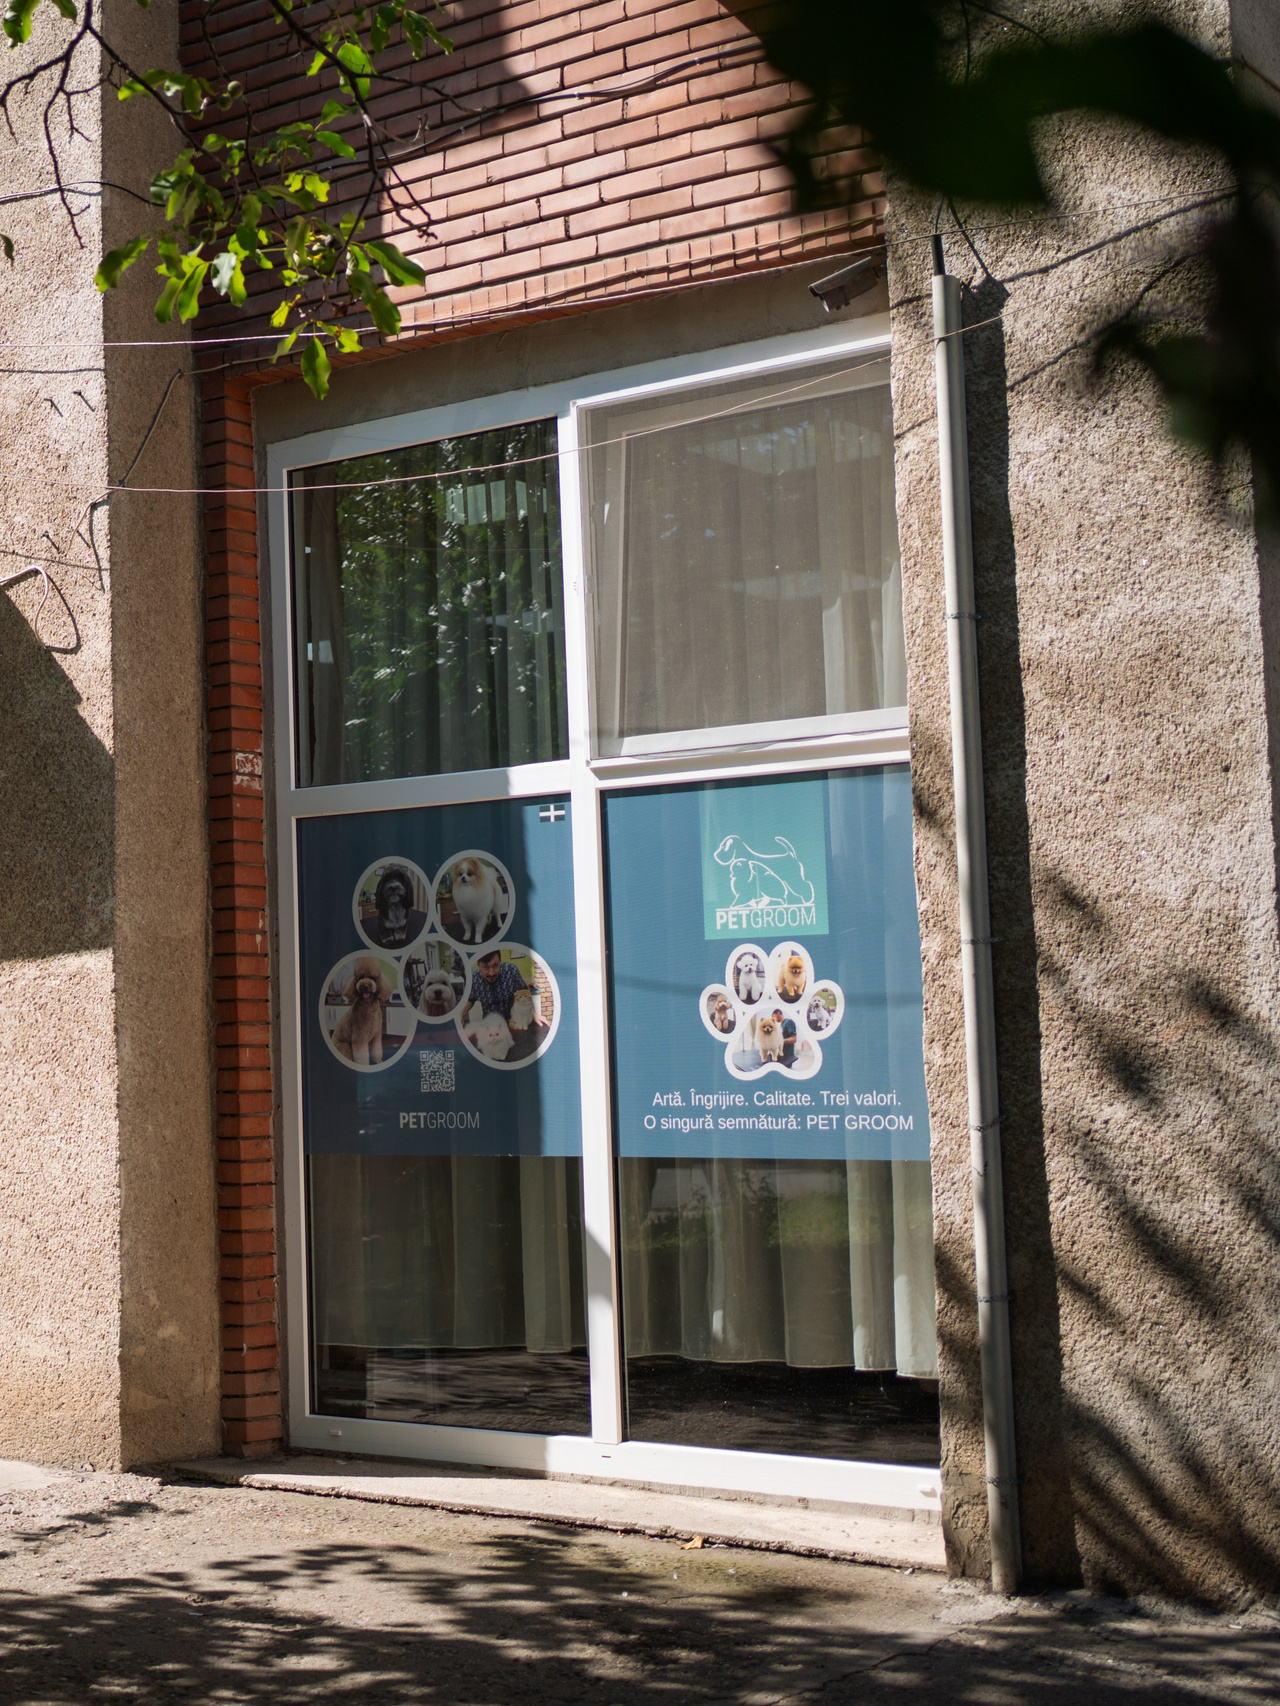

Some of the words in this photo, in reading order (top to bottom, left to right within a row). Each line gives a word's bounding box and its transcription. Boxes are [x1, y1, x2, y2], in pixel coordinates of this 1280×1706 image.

[716, 906, 816, 930] PETGROOM
[652, 1091, 686, 1106] Artă.
[689, 1088, 749, 1110] Îngrijire.
[753, 1090, 816, 1106] Calitate.
[819, 1090, 850, 1106] Trei
[853, 1090, 902, 1106] valori.
[399, 1111, 480, 1129] PETGROOM
[643, 1114, 657, 1129] O
[660, 1114, 714, 1133] singură
[717, 1113, 801, 1130] semnătură:
[806, 1114, 841, 1130] PET
[844, 1114, 914, 1130] GROOM
